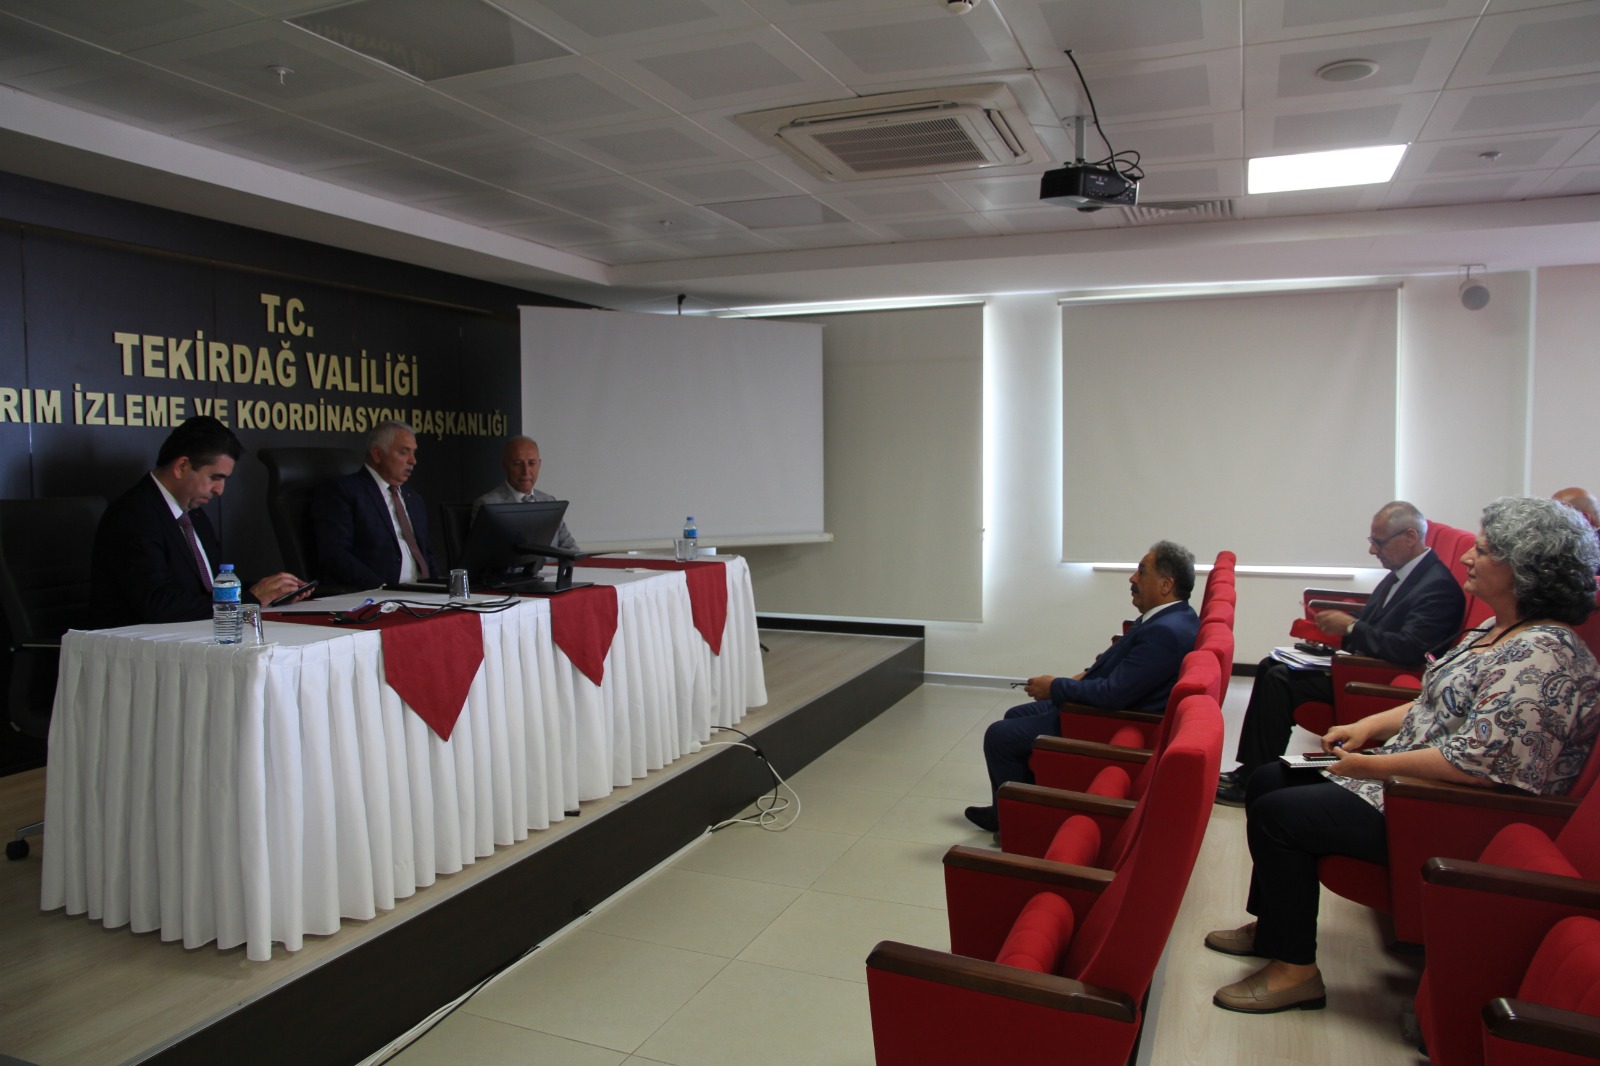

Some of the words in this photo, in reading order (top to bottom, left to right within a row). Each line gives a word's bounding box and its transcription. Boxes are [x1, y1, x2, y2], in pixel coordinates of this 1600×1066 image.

[260, 293, 315, 338] T.C.
[113, 329, 298, 388] TEKİRDAĞ
[305, 349, 419, 397] VALİLİĞİ
[72, 383, 186, 427] İZLEME
[192, 397, 230, 429] VE
[411, 409, 508, 441] BAŞKANLIĞI
